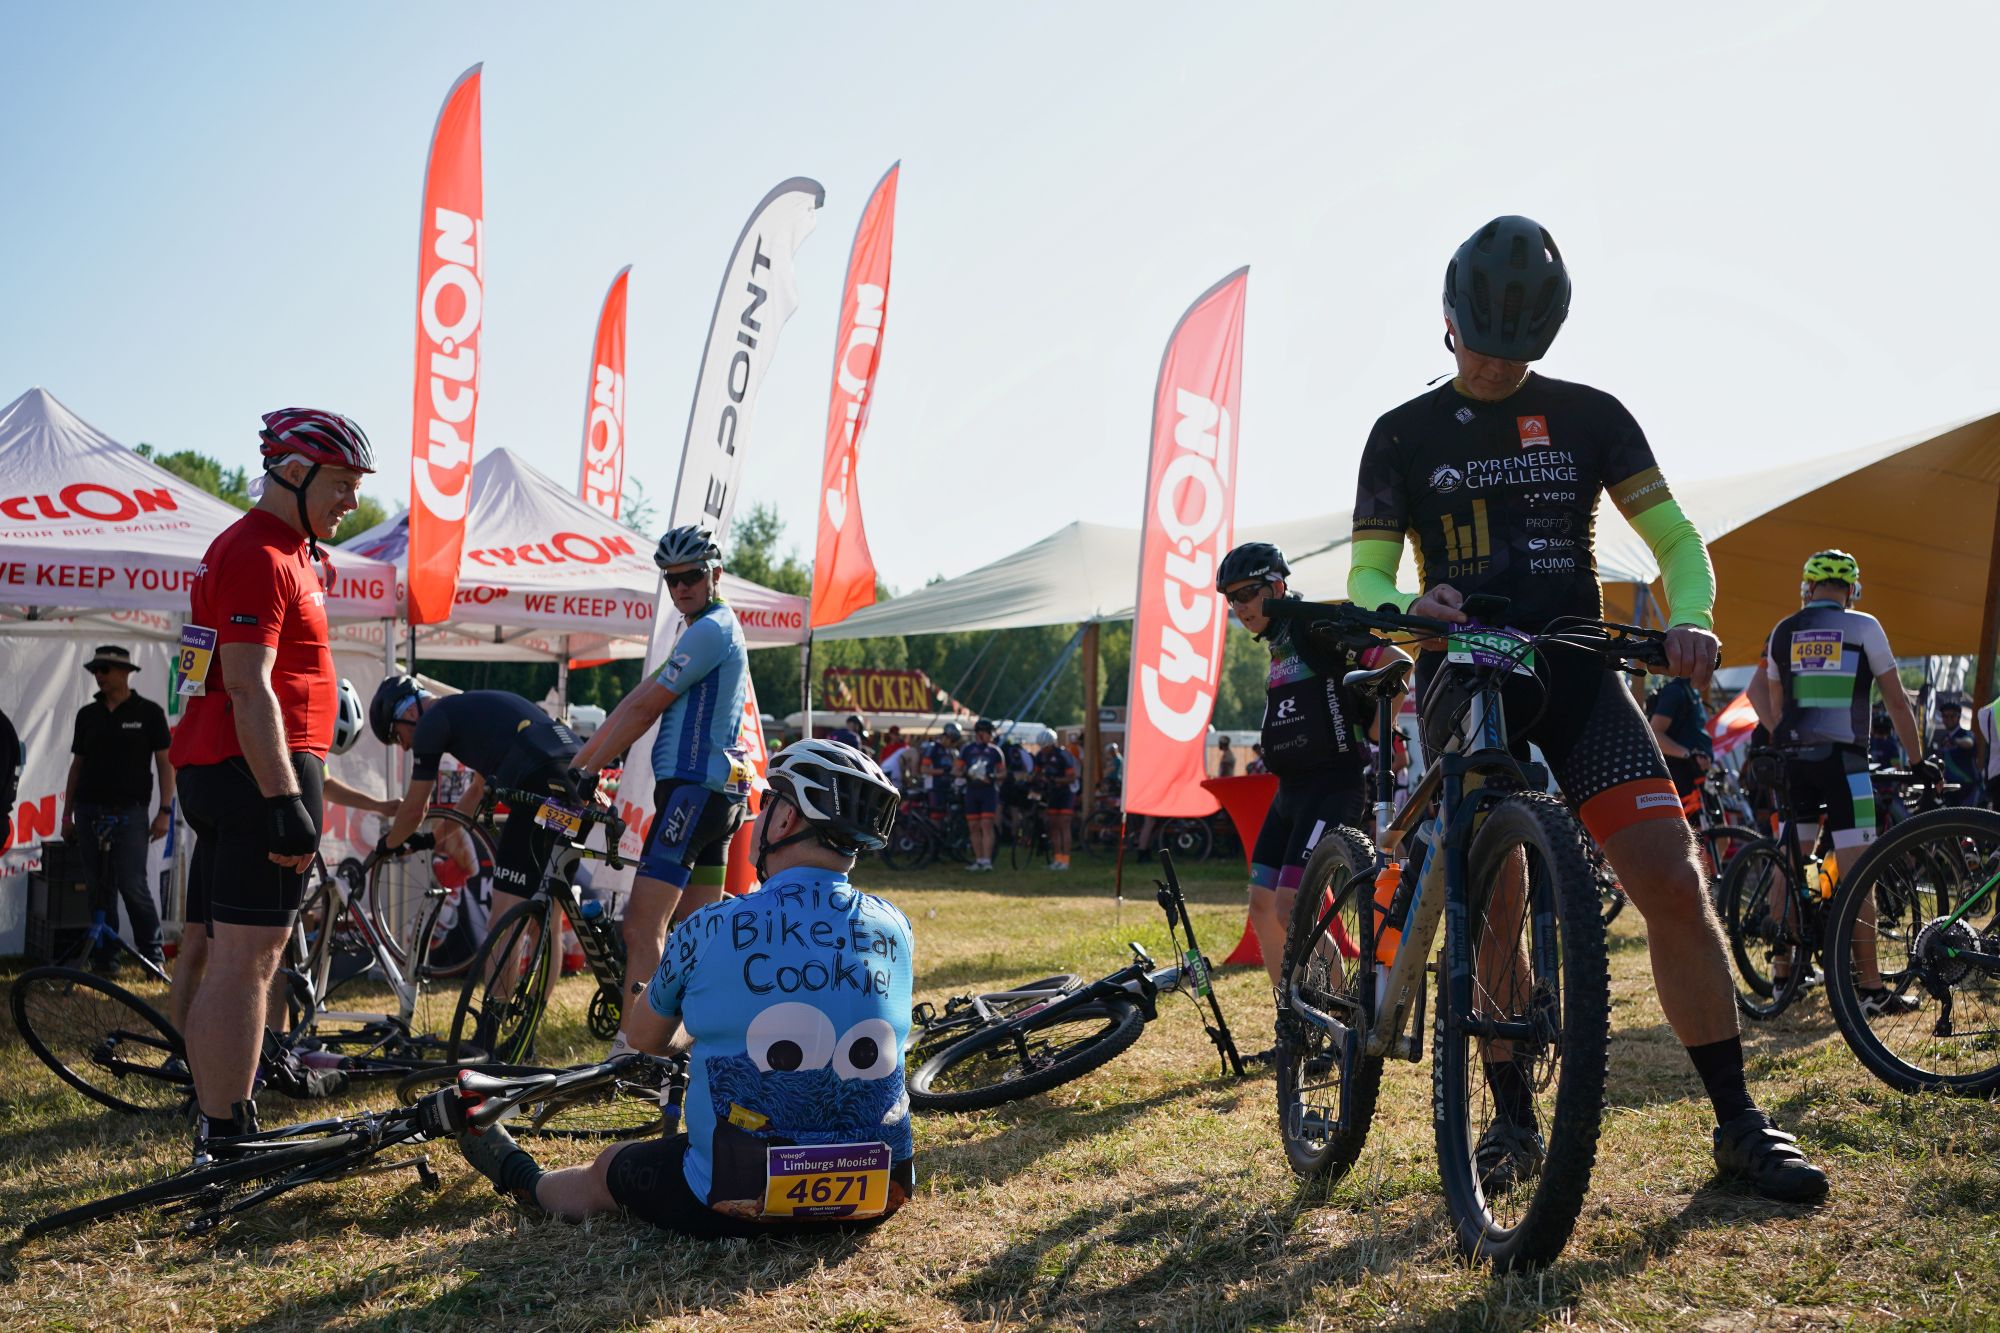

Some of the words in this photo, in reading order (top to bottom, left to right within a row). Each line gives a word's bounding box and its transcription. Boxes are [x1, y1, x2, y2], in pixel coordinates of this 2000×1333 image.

[718, 233, 771, 457] POINT
[1467, 452, 1574, 475] PYRENEEEN
[1466, 466, 1578, 489] CHALLENGE
[1543, 492, 1575, 501] vepa
[63, 526, 107, 537] BIKE
[114, 521, 191, 534] SMILING
[467, 532, 636, 566] CYCLON
[1448, 560, 1491, 579] DHF
[1530, 558, 1575, 570] KUMO
[36, 564, 116, 589] KEEP
[124, 568, 195, 592] YOUR
[524, 594, 557, 613] WE
[563, 597, 617, 617] KEEP
[623, 602, 653, 620] YO
[1797, 643, 1833, 657] 4688
[1271, 715, 1306, 727] GEERDINK
[546, 809, 573, 826] 5224
[848, 918, 898, 963] Eat
[743, 951, 892, 999] Cookie!
[1190, 953, 1207, 990] 10611
[1434, 1017, 1446, 1121] MAXXIS
[783, 1160, 834, 1171] Limburgs
[837, 1157, 878, 1168] Mooiste
[786, 1174, 868, 1204] 4671
